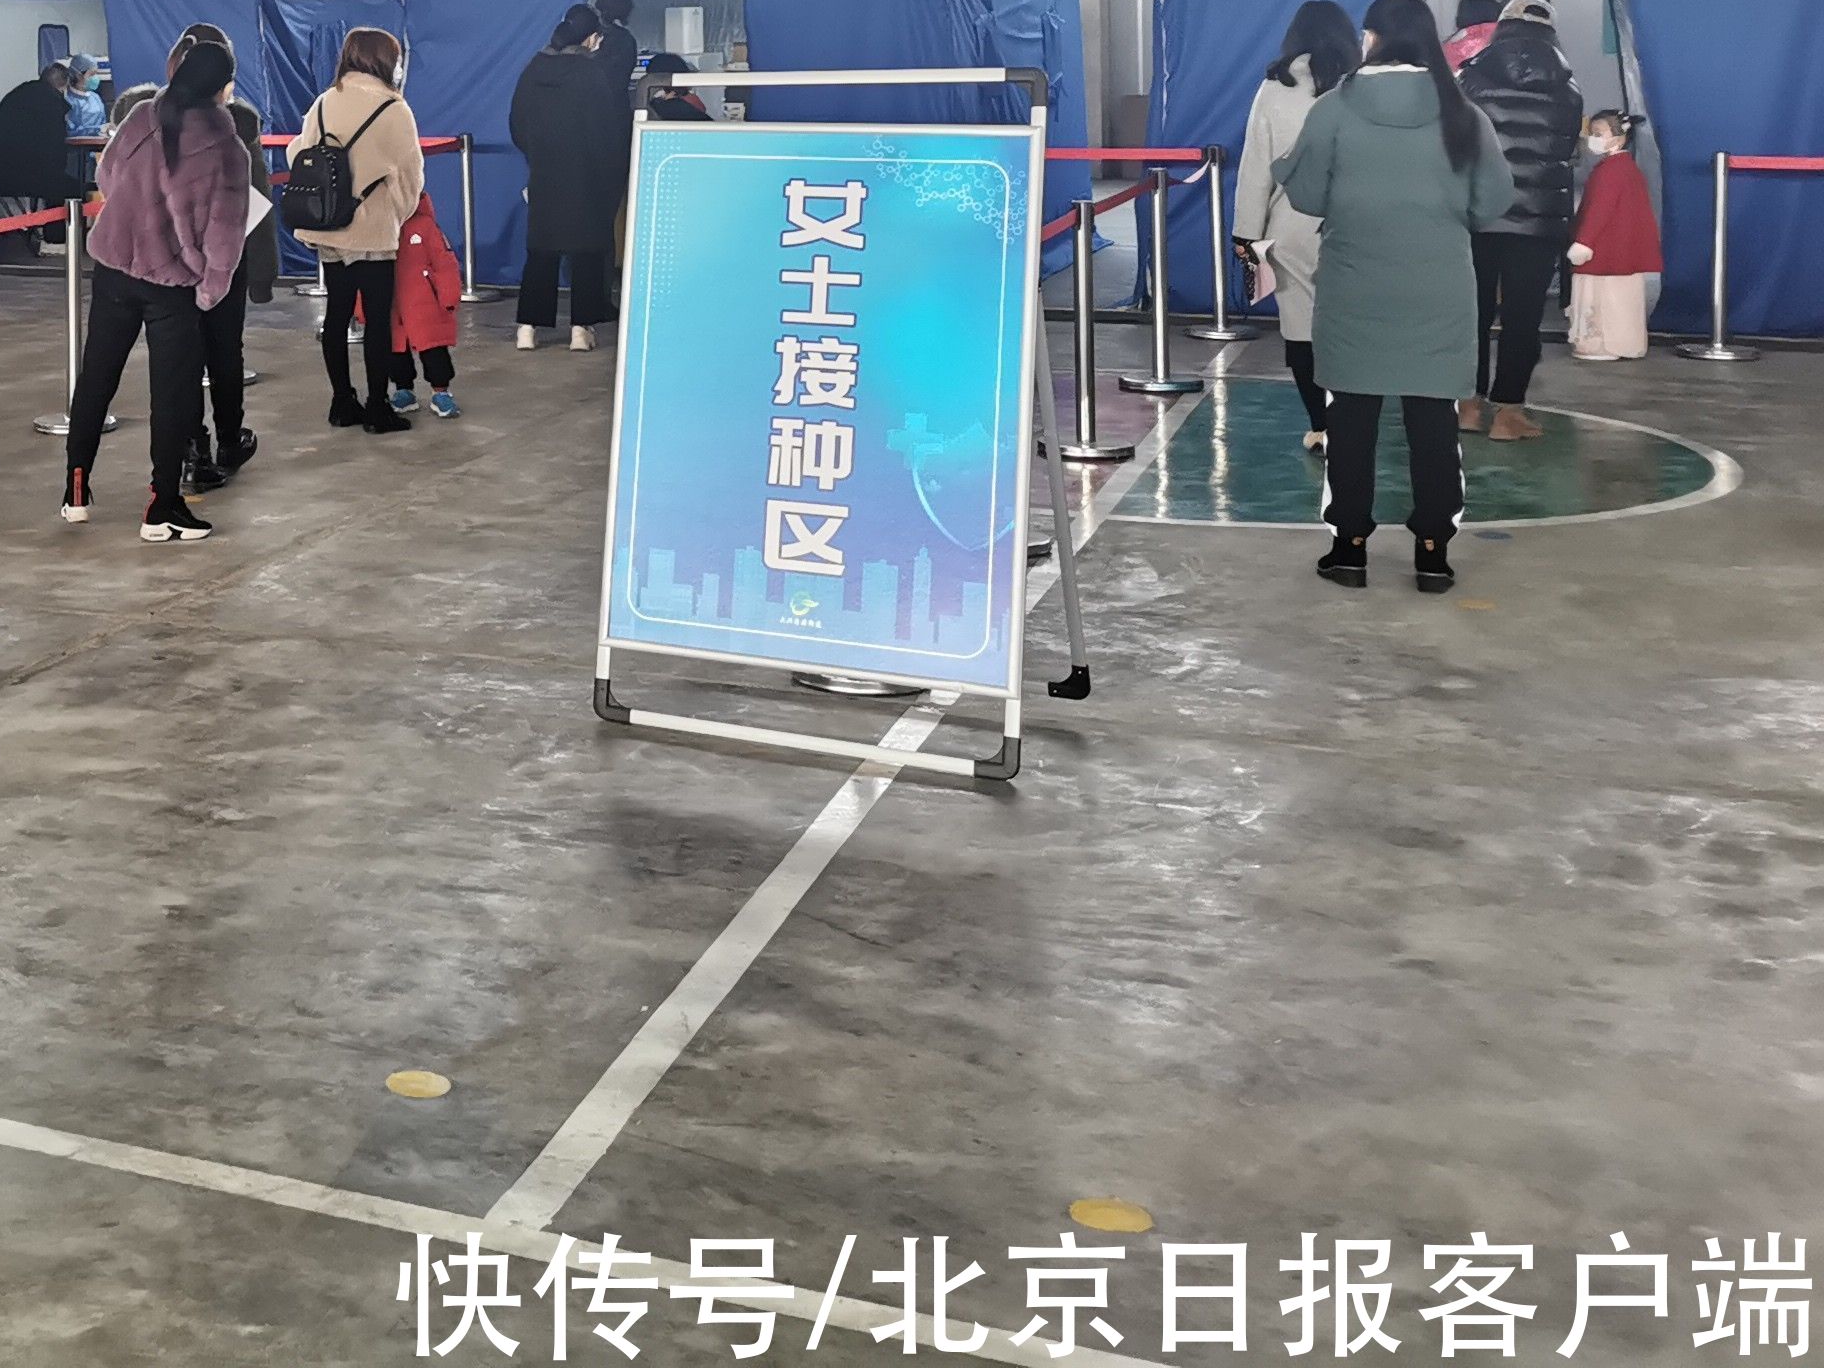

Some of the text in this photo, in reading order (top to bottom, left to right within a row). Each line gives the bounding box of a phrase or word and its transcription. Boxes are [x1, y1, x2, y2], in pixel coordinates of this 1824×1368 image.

[763, 178, 868, 576] 女士接种区
